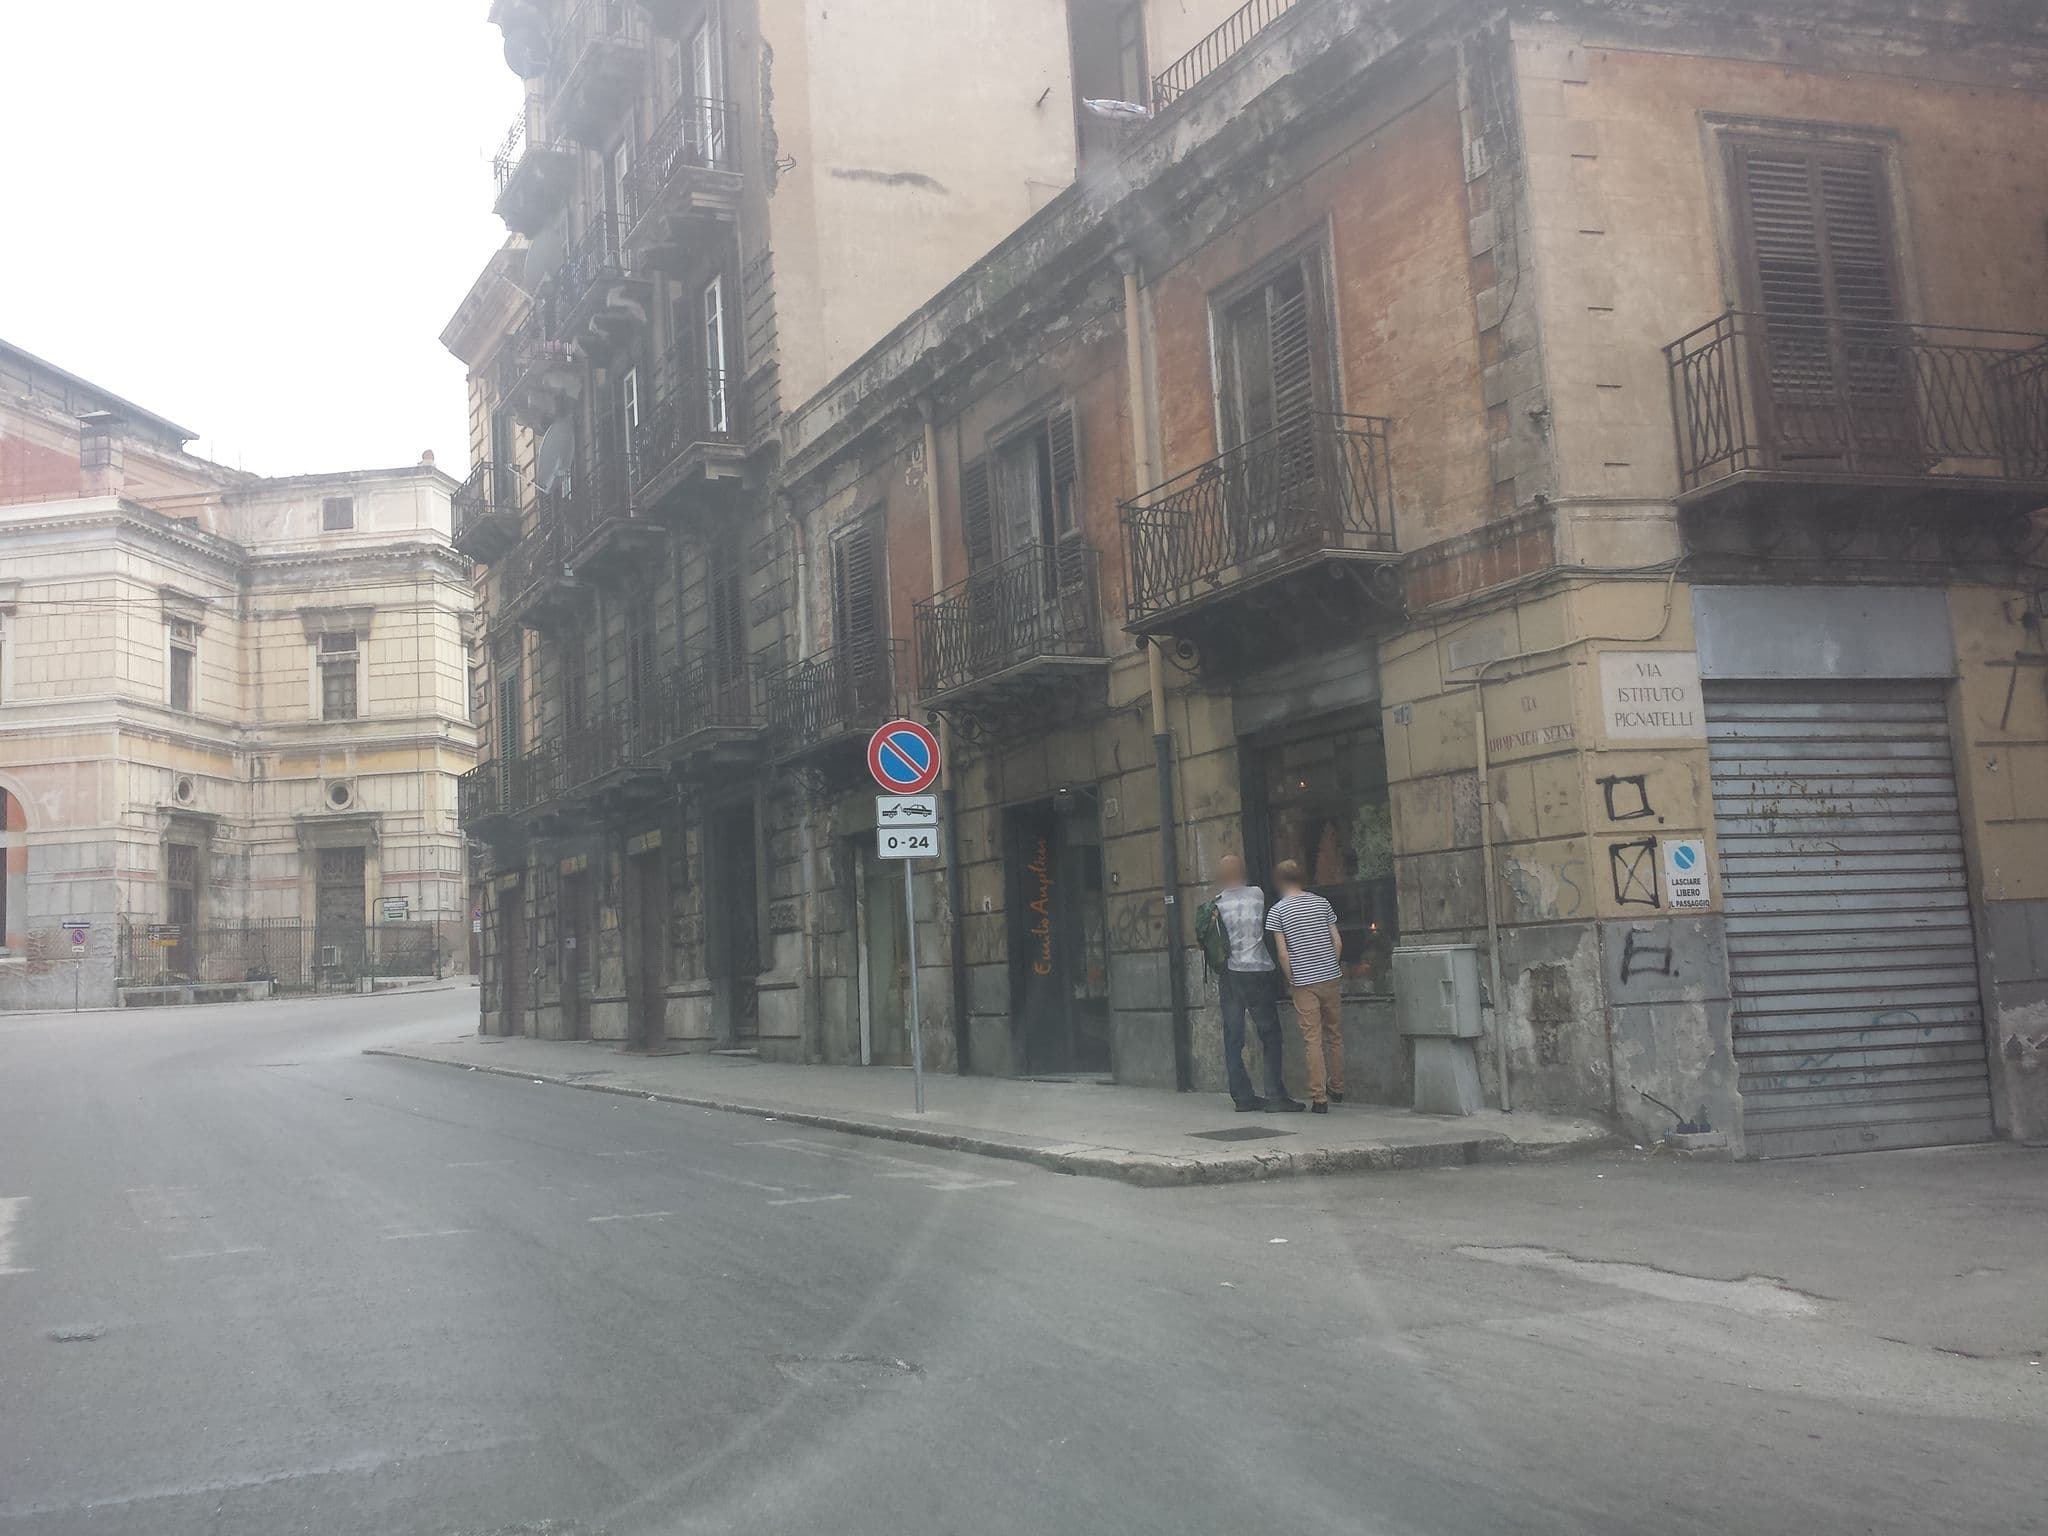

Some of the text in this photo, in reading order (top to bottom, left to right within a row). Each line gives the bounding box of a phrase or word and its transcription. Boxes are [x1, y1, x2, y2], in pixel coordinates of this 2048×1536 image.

[1636, 663, 1662, 678] VIA
[1618, 687, 1684, 702] ISTITUTO
[1615, 711, 1693, 727] PIGNATELLI
[1671, 878, 1701, 886] LASCIARE
[1676, 888, 1700, 896] LIBERO
